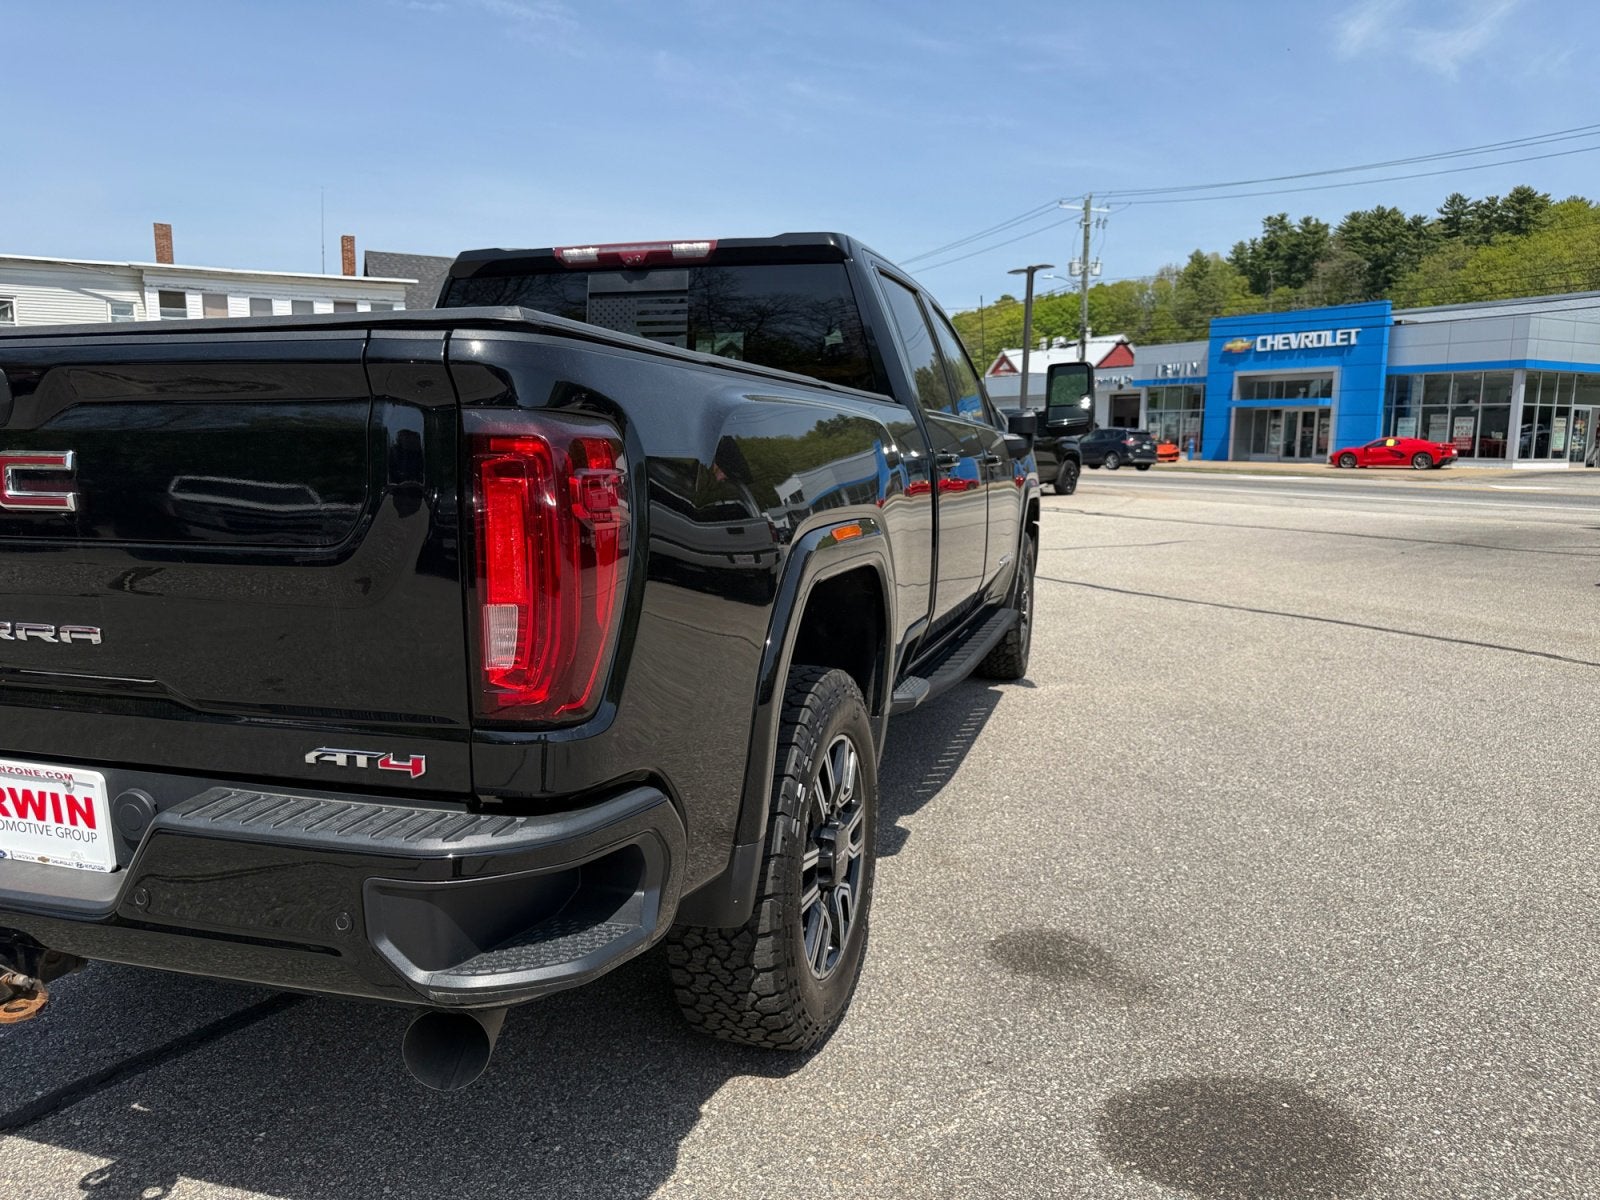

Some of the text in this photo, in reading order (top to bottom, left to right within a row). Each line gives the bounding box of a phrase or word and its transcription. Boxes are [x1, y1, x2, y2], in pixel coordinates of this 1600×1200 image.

[1256, 328, 1362, 352] CHEVROLET
[1156, 361, 1199, 378] IRWIN
[305, 747, 425, 779] AT4
[55, 826, 98, 844] GROUP
